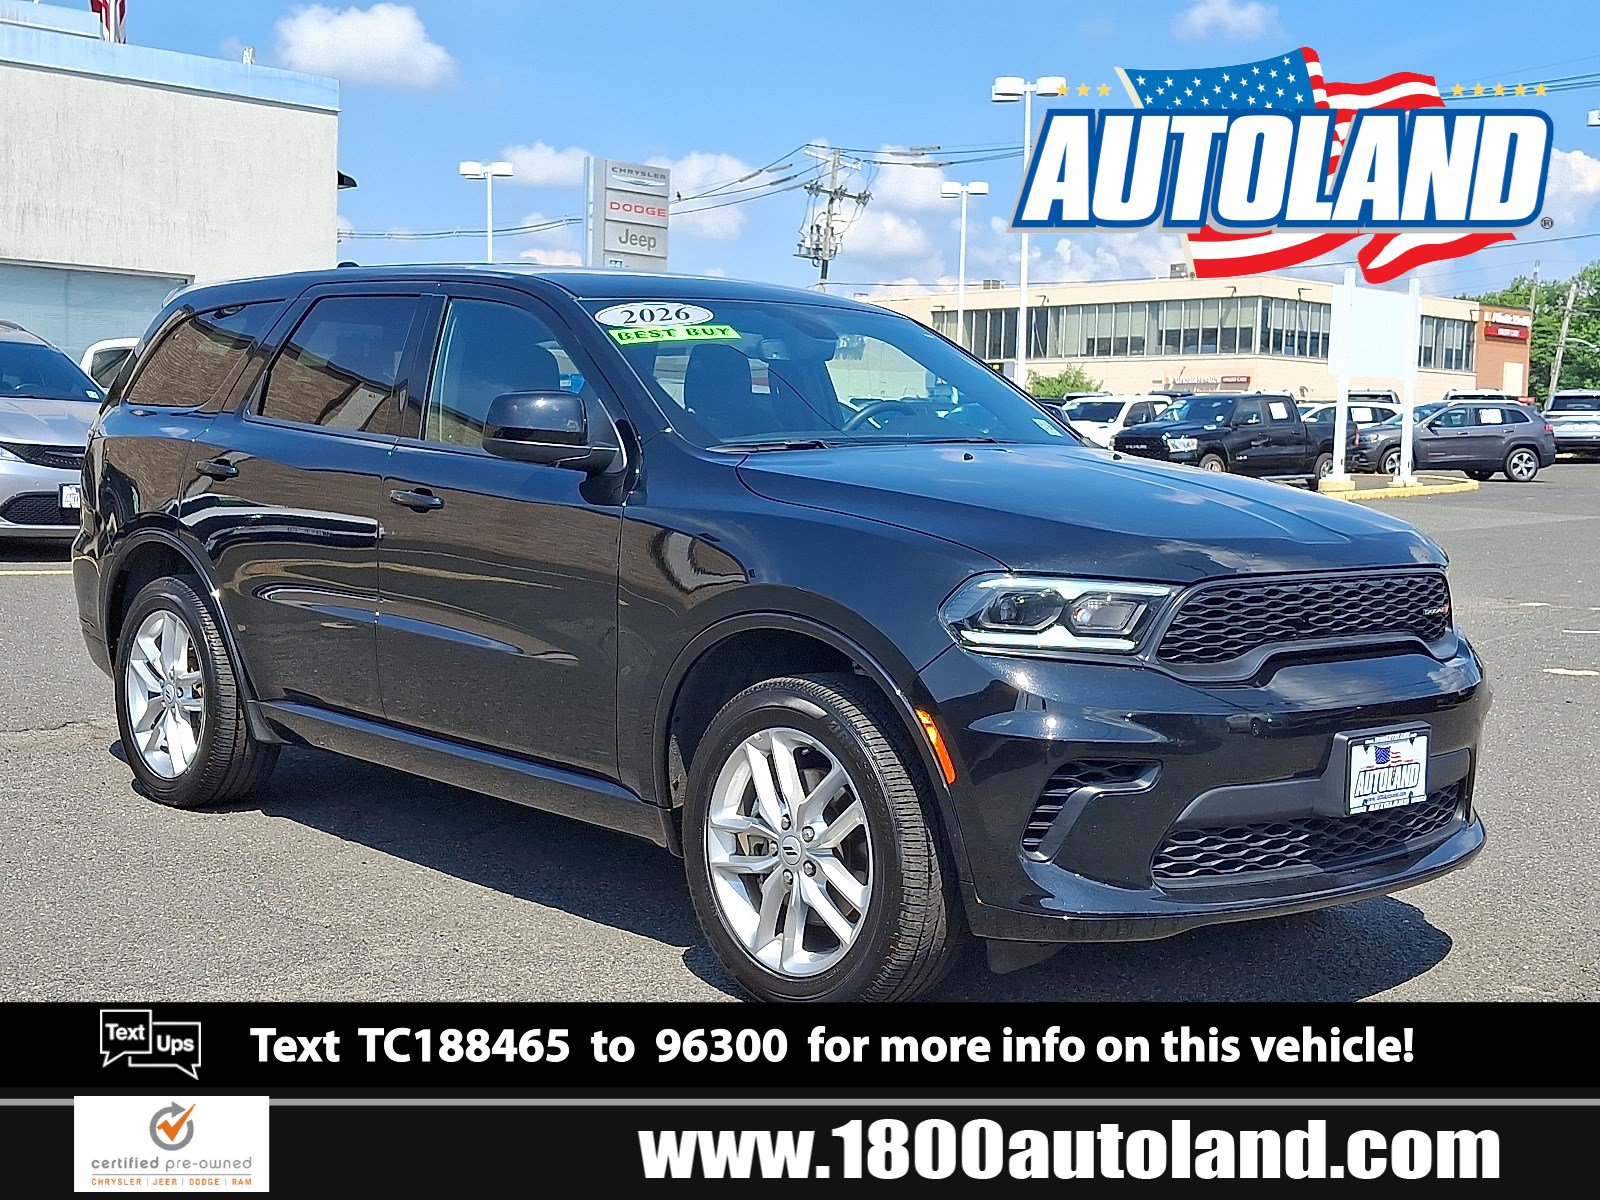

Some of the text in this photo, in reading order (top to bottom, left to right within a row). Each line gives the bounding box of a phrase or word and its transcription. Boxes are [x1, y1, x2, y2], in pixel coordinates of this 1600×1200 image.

[611, 166, 667, 180] CHRYSLER
[609, 201, 667, 218] DODGE
[618, 228, 657, 251] Jeep
[620, 307, 690, 324] 2026
[617, 327, 730, 341] BEST BUY
[1354, 763, 1420, 798] AUTOLAND
